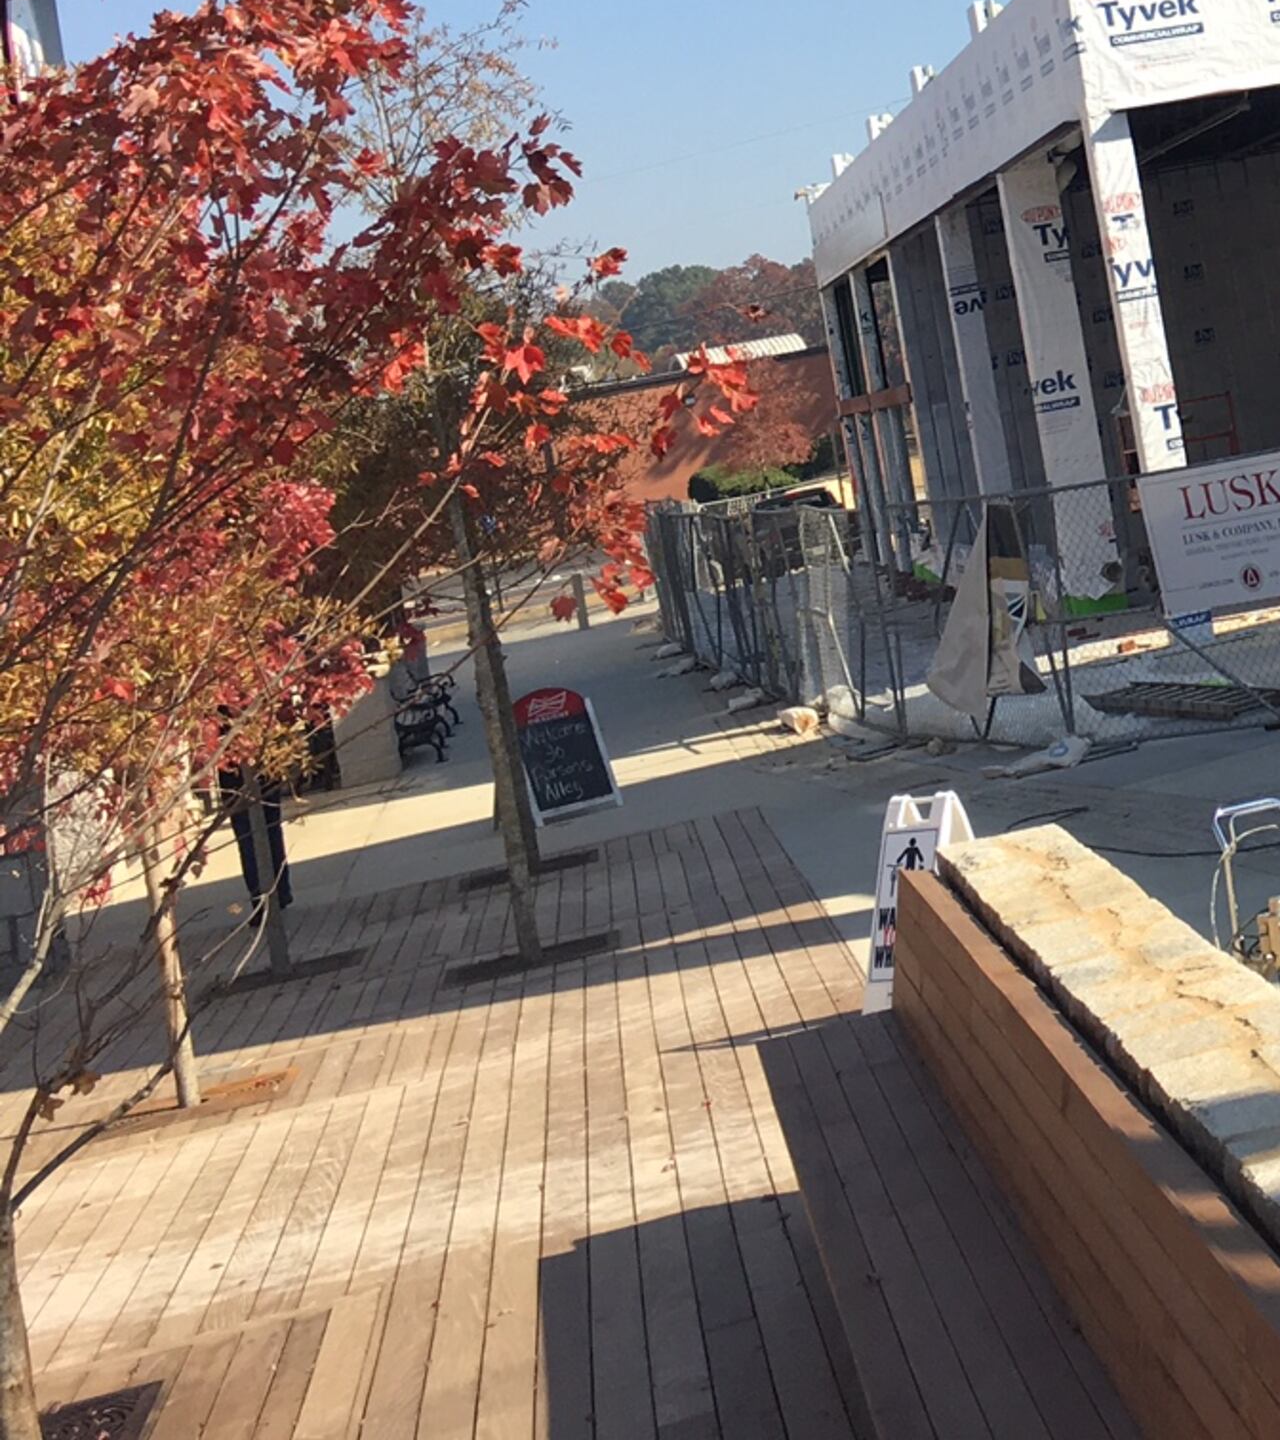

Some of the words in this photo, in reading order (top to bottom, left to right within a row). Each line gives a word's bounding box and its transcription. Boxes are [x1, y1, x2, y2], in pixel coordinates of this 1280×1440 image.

[1032, 369, 1077, 395] vek
[1183, 530, 1211, 545] LUSK
[879, 907, 896, 930] WA
